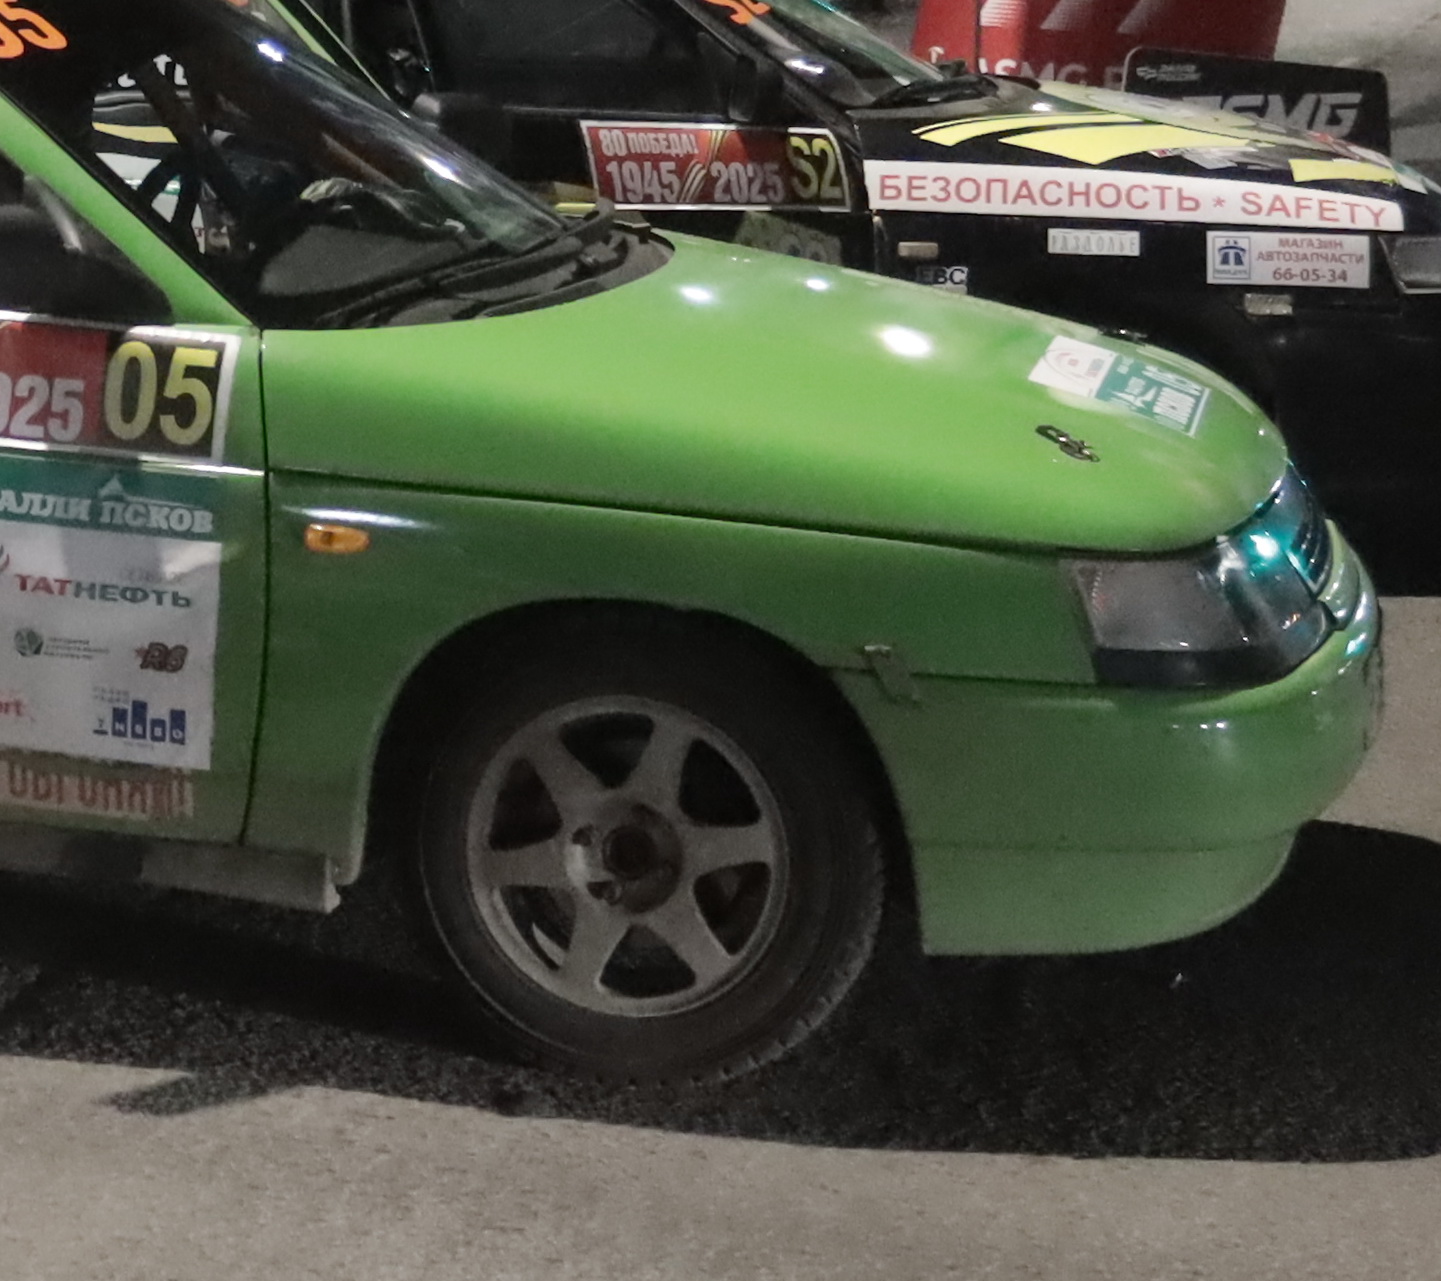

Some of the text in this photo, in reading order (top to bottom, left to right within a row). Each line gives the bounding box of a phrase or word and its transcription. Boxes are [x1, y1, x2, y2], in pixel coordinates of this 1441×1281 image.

[598, 128, 700, 161] 80 ПОБЕДА!
[605, 160, 786, 206] 1945 2025
[878, 173, 1387, 228] БЕЗОПАСНОСТЬ SAFETY
[1256, 250, 1365, 265] АВТОЗАПЧАСТИ
[1278, 237, 1344, 250] МАГАЗИН
[1272, 268, 1348, 283] 66-05-34
[104, 340, 219, 447] 05
[99, 499, 213, 534] ПСКОВ
[14, 573, 192, 609] ТАТНЕФТЬ
